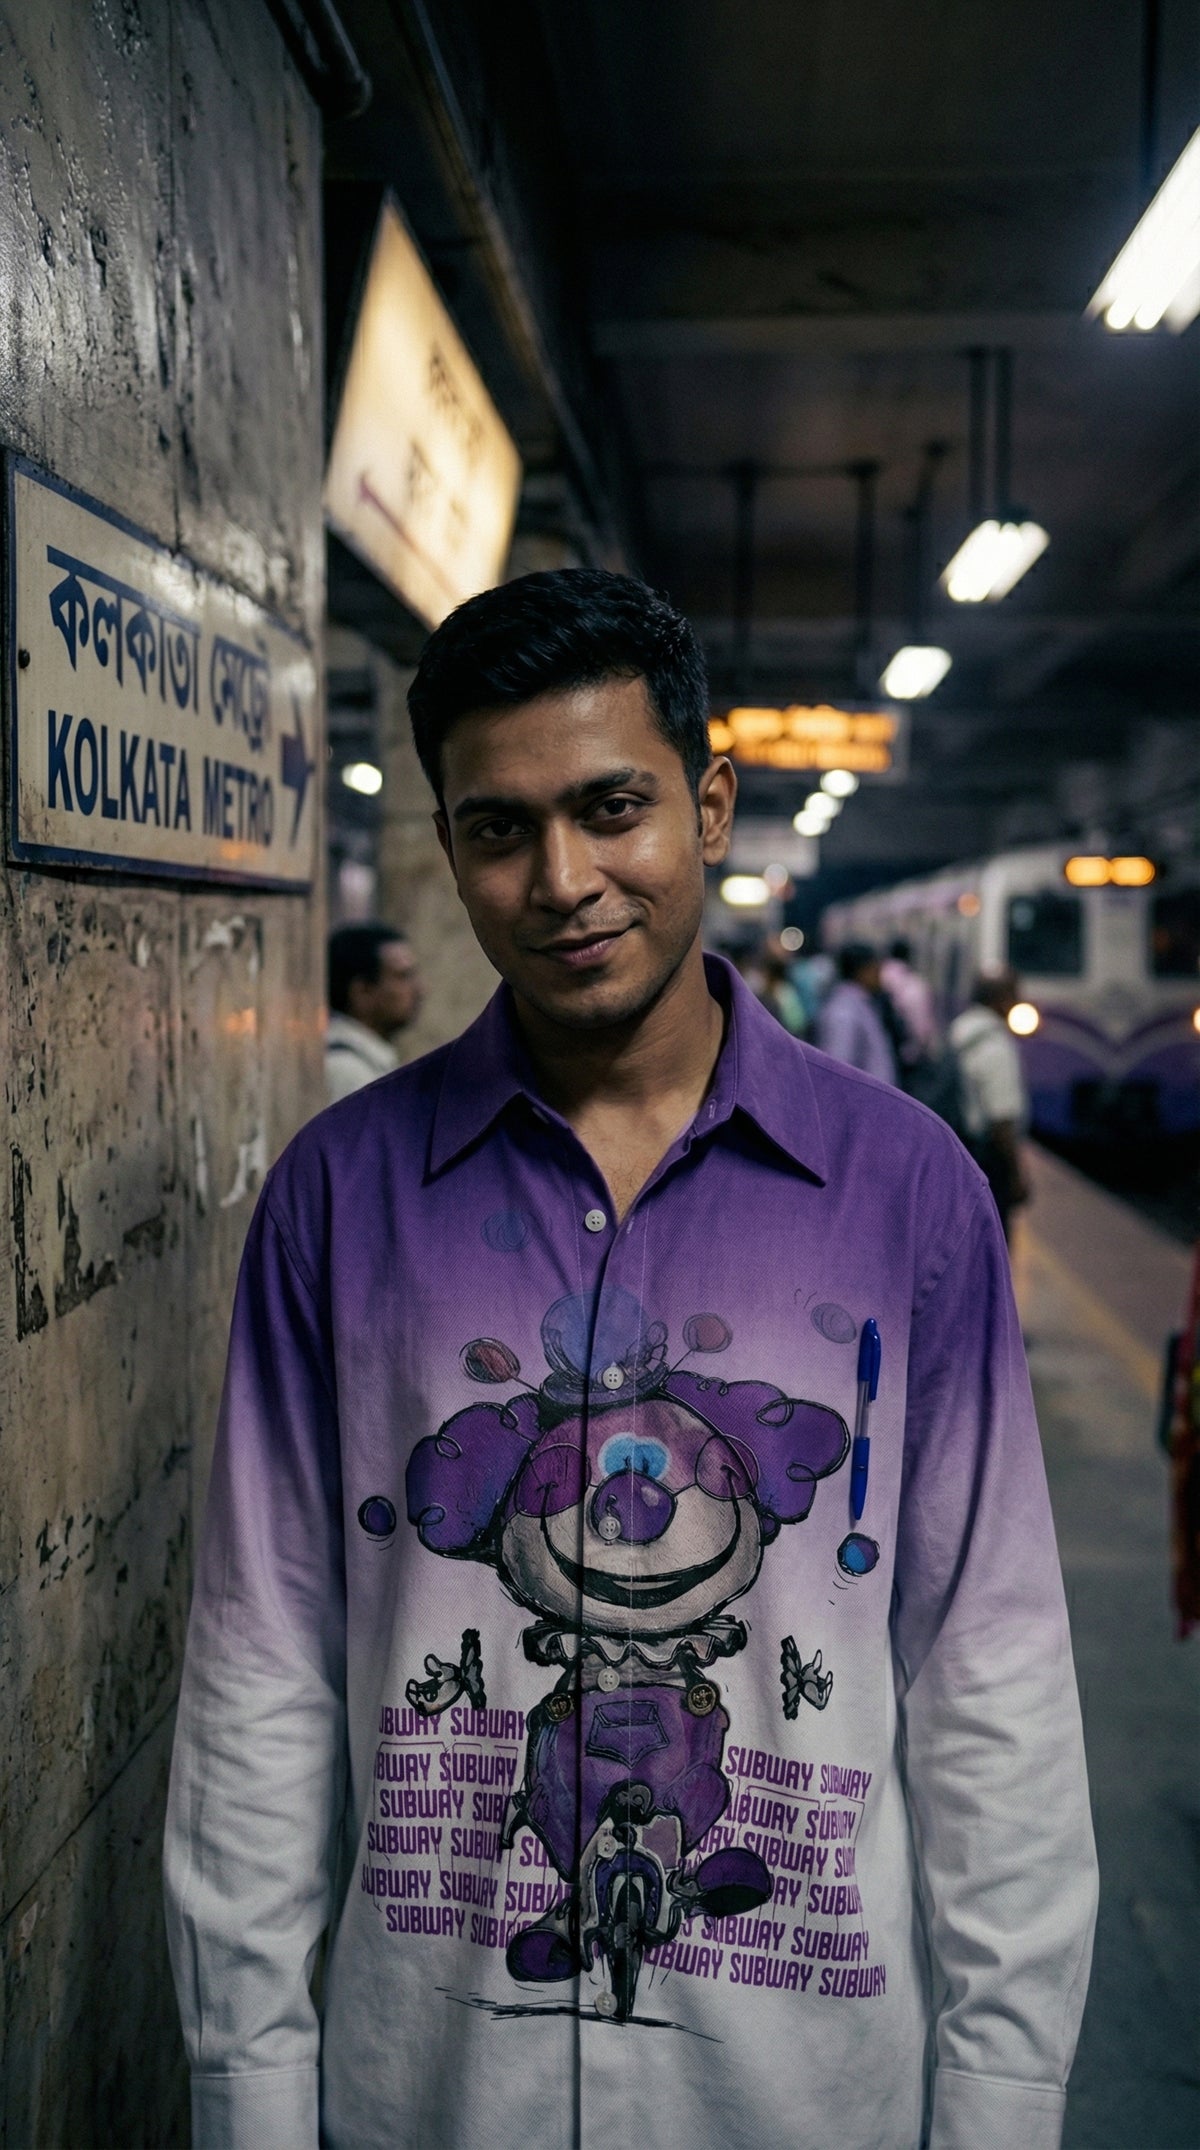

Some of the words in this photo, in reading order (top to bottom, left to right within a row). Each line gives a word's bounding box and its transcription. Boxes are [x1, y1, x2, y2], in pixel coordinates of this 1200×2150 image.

[47, 545, 201, 714] কলকাতা
[47, 709, 191, 832] KOLKATA
[203, 756, 274, 847] METRO
[439, 1752, 518, 1787] SUBWAY
[725, 1745, 814, 1792] SUBWAY
[379, 1788, 465, 1820] SUBWAY
[367, 1821, 443, 1856] SUBWAY
[385, 1903, 466, 1940] SUBWAY
[790, 1925, 870, 1963] SUBWAY
[729, 1952, 814, 1993] SUBWAY
[818, 1964, 887, 1999] SUBWAY
